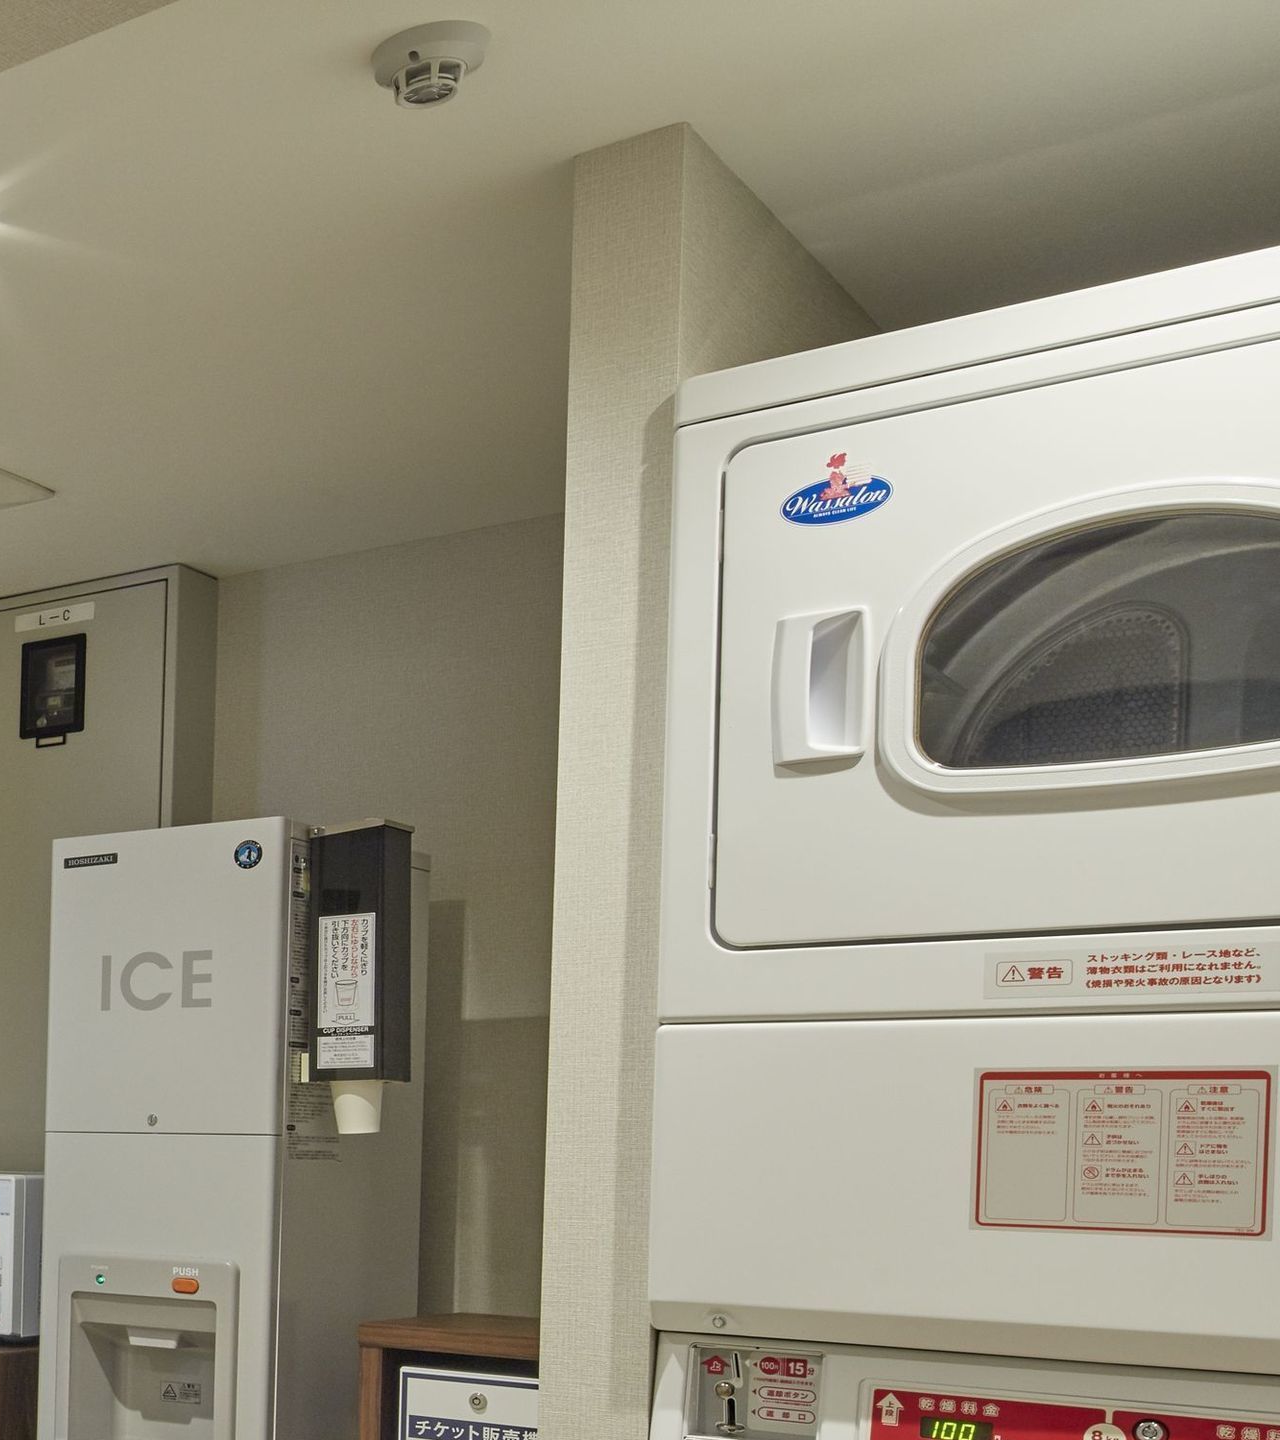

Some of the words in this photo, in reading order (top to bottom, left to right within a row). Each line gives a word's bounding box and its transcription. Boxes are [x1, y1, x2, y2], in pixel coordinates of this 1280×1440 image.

[785, 485, 887, 516] Wassalon
[68, 856, 114, 867] HOSHIZAKI
[1087, 948, 1261, 964] ストッキング類・レース地など、
[1027, 966, 1064, 980] 警告
[1086, 960, 1261, 976] 薄物衣類はご利用になれません。
[100, 950, 213, 1012] ICE
[336, 1025, 369, 1033] DISPENSER
[172, 1266, 199, 1277] PUSH
[710, 1361, 721, 1372] 上
[788, 1362, 804, 1375] 15
